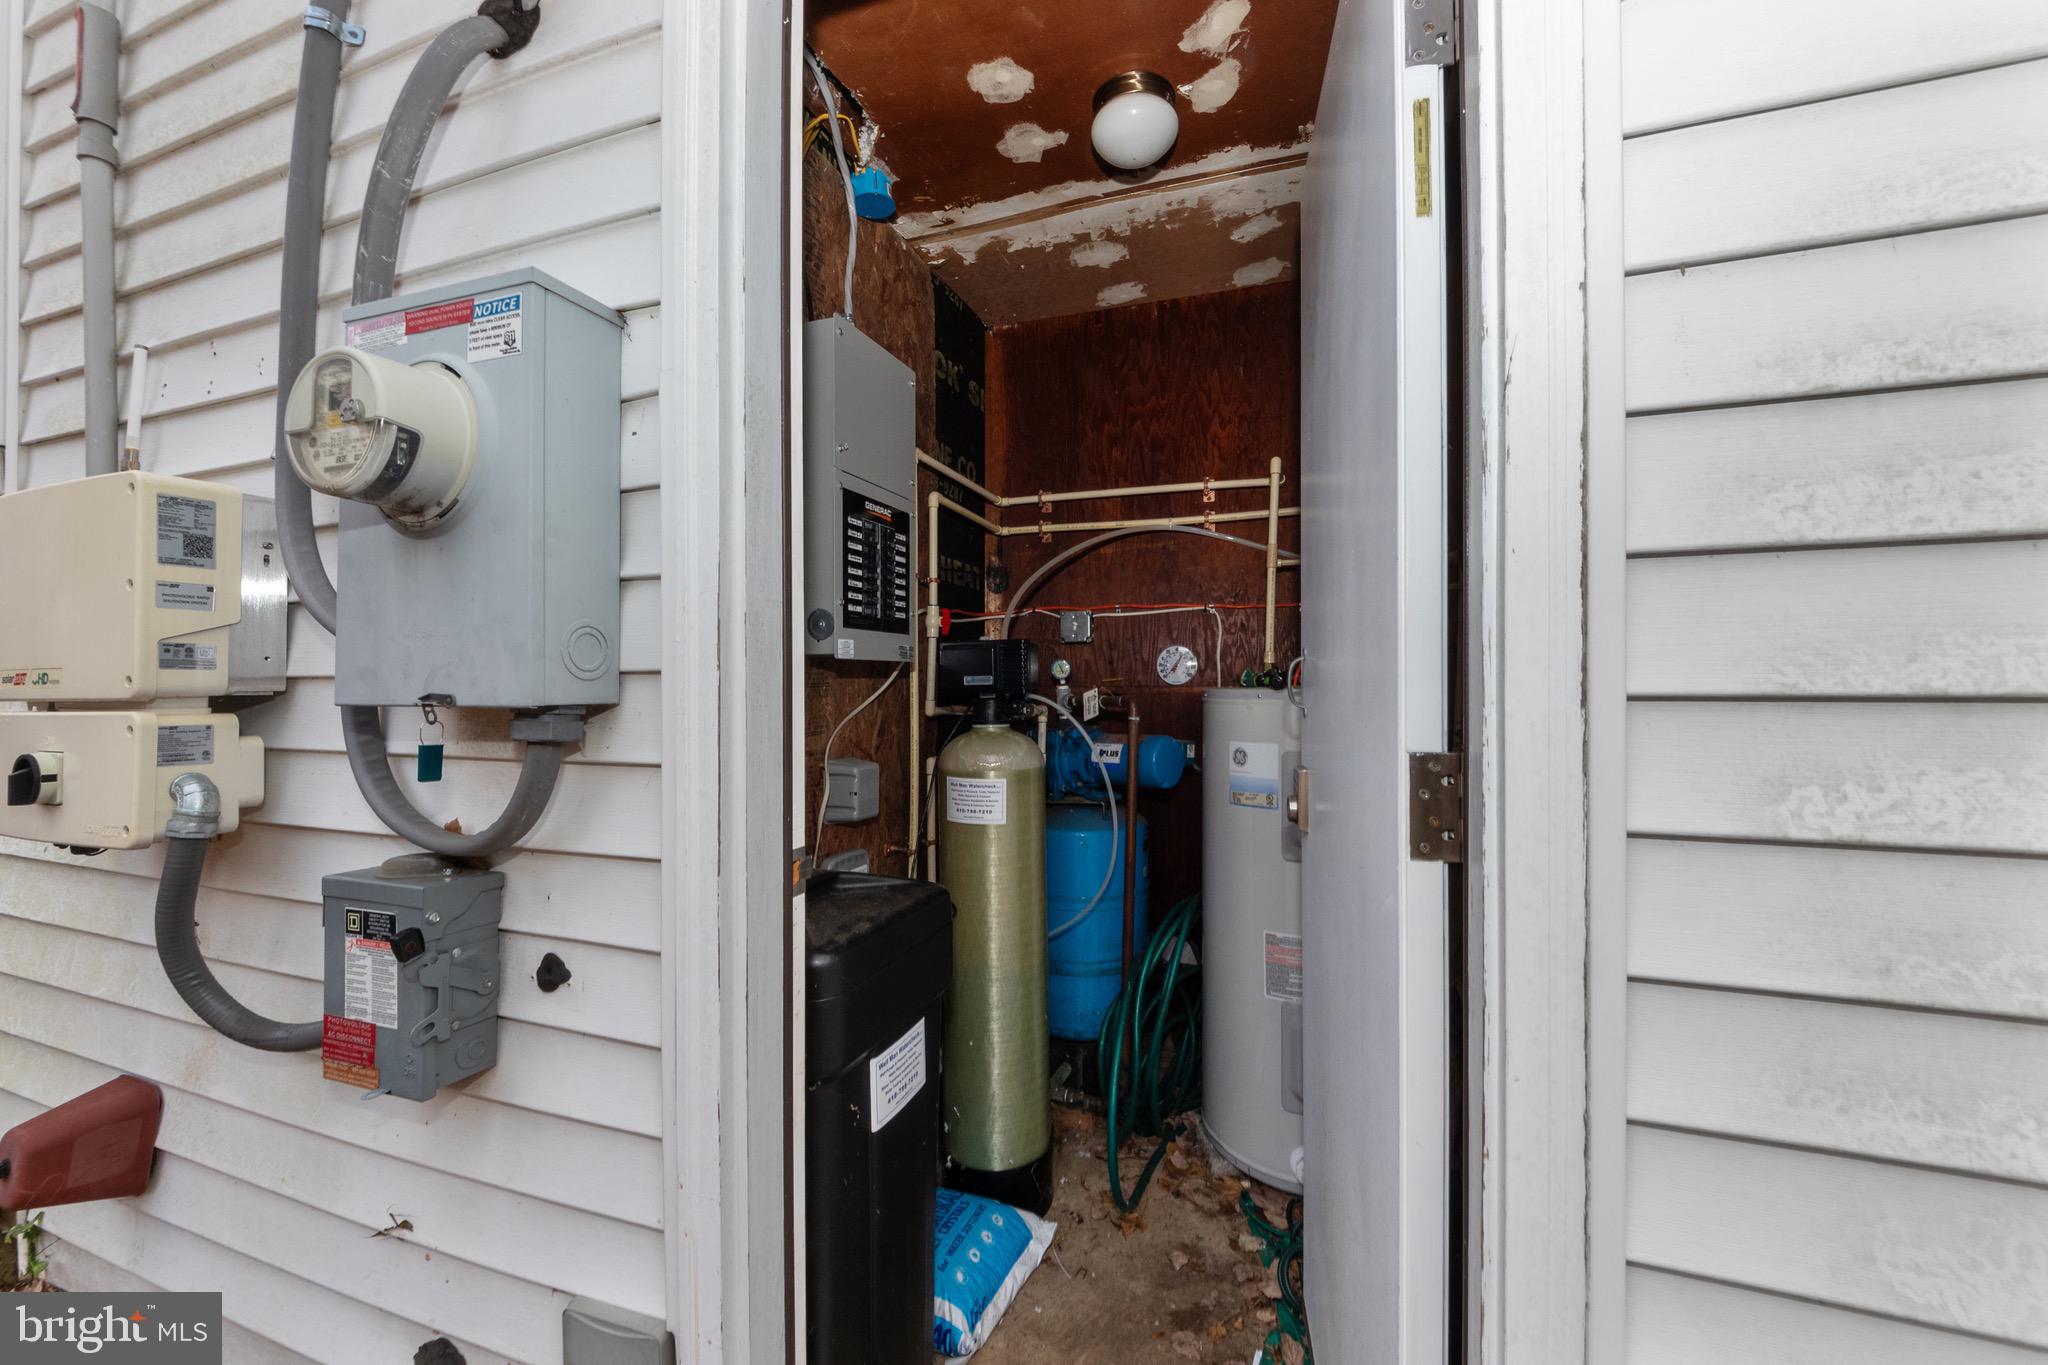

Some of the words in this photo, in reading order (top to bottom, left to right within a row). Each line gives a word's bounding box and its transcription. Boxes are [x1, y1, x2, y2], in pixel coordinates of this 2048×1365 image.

[474, 297, 518, 318] NOTICE
[864, 501, 892, 517] GENERAC
[327, 1016, 371, 1030] PHOTOVOLTAIC
[336, 1032, 371, 1045] DISCONNECT
[938, 1258, 950, 1273] for
[946, 1232, 963, 1257] WATER
